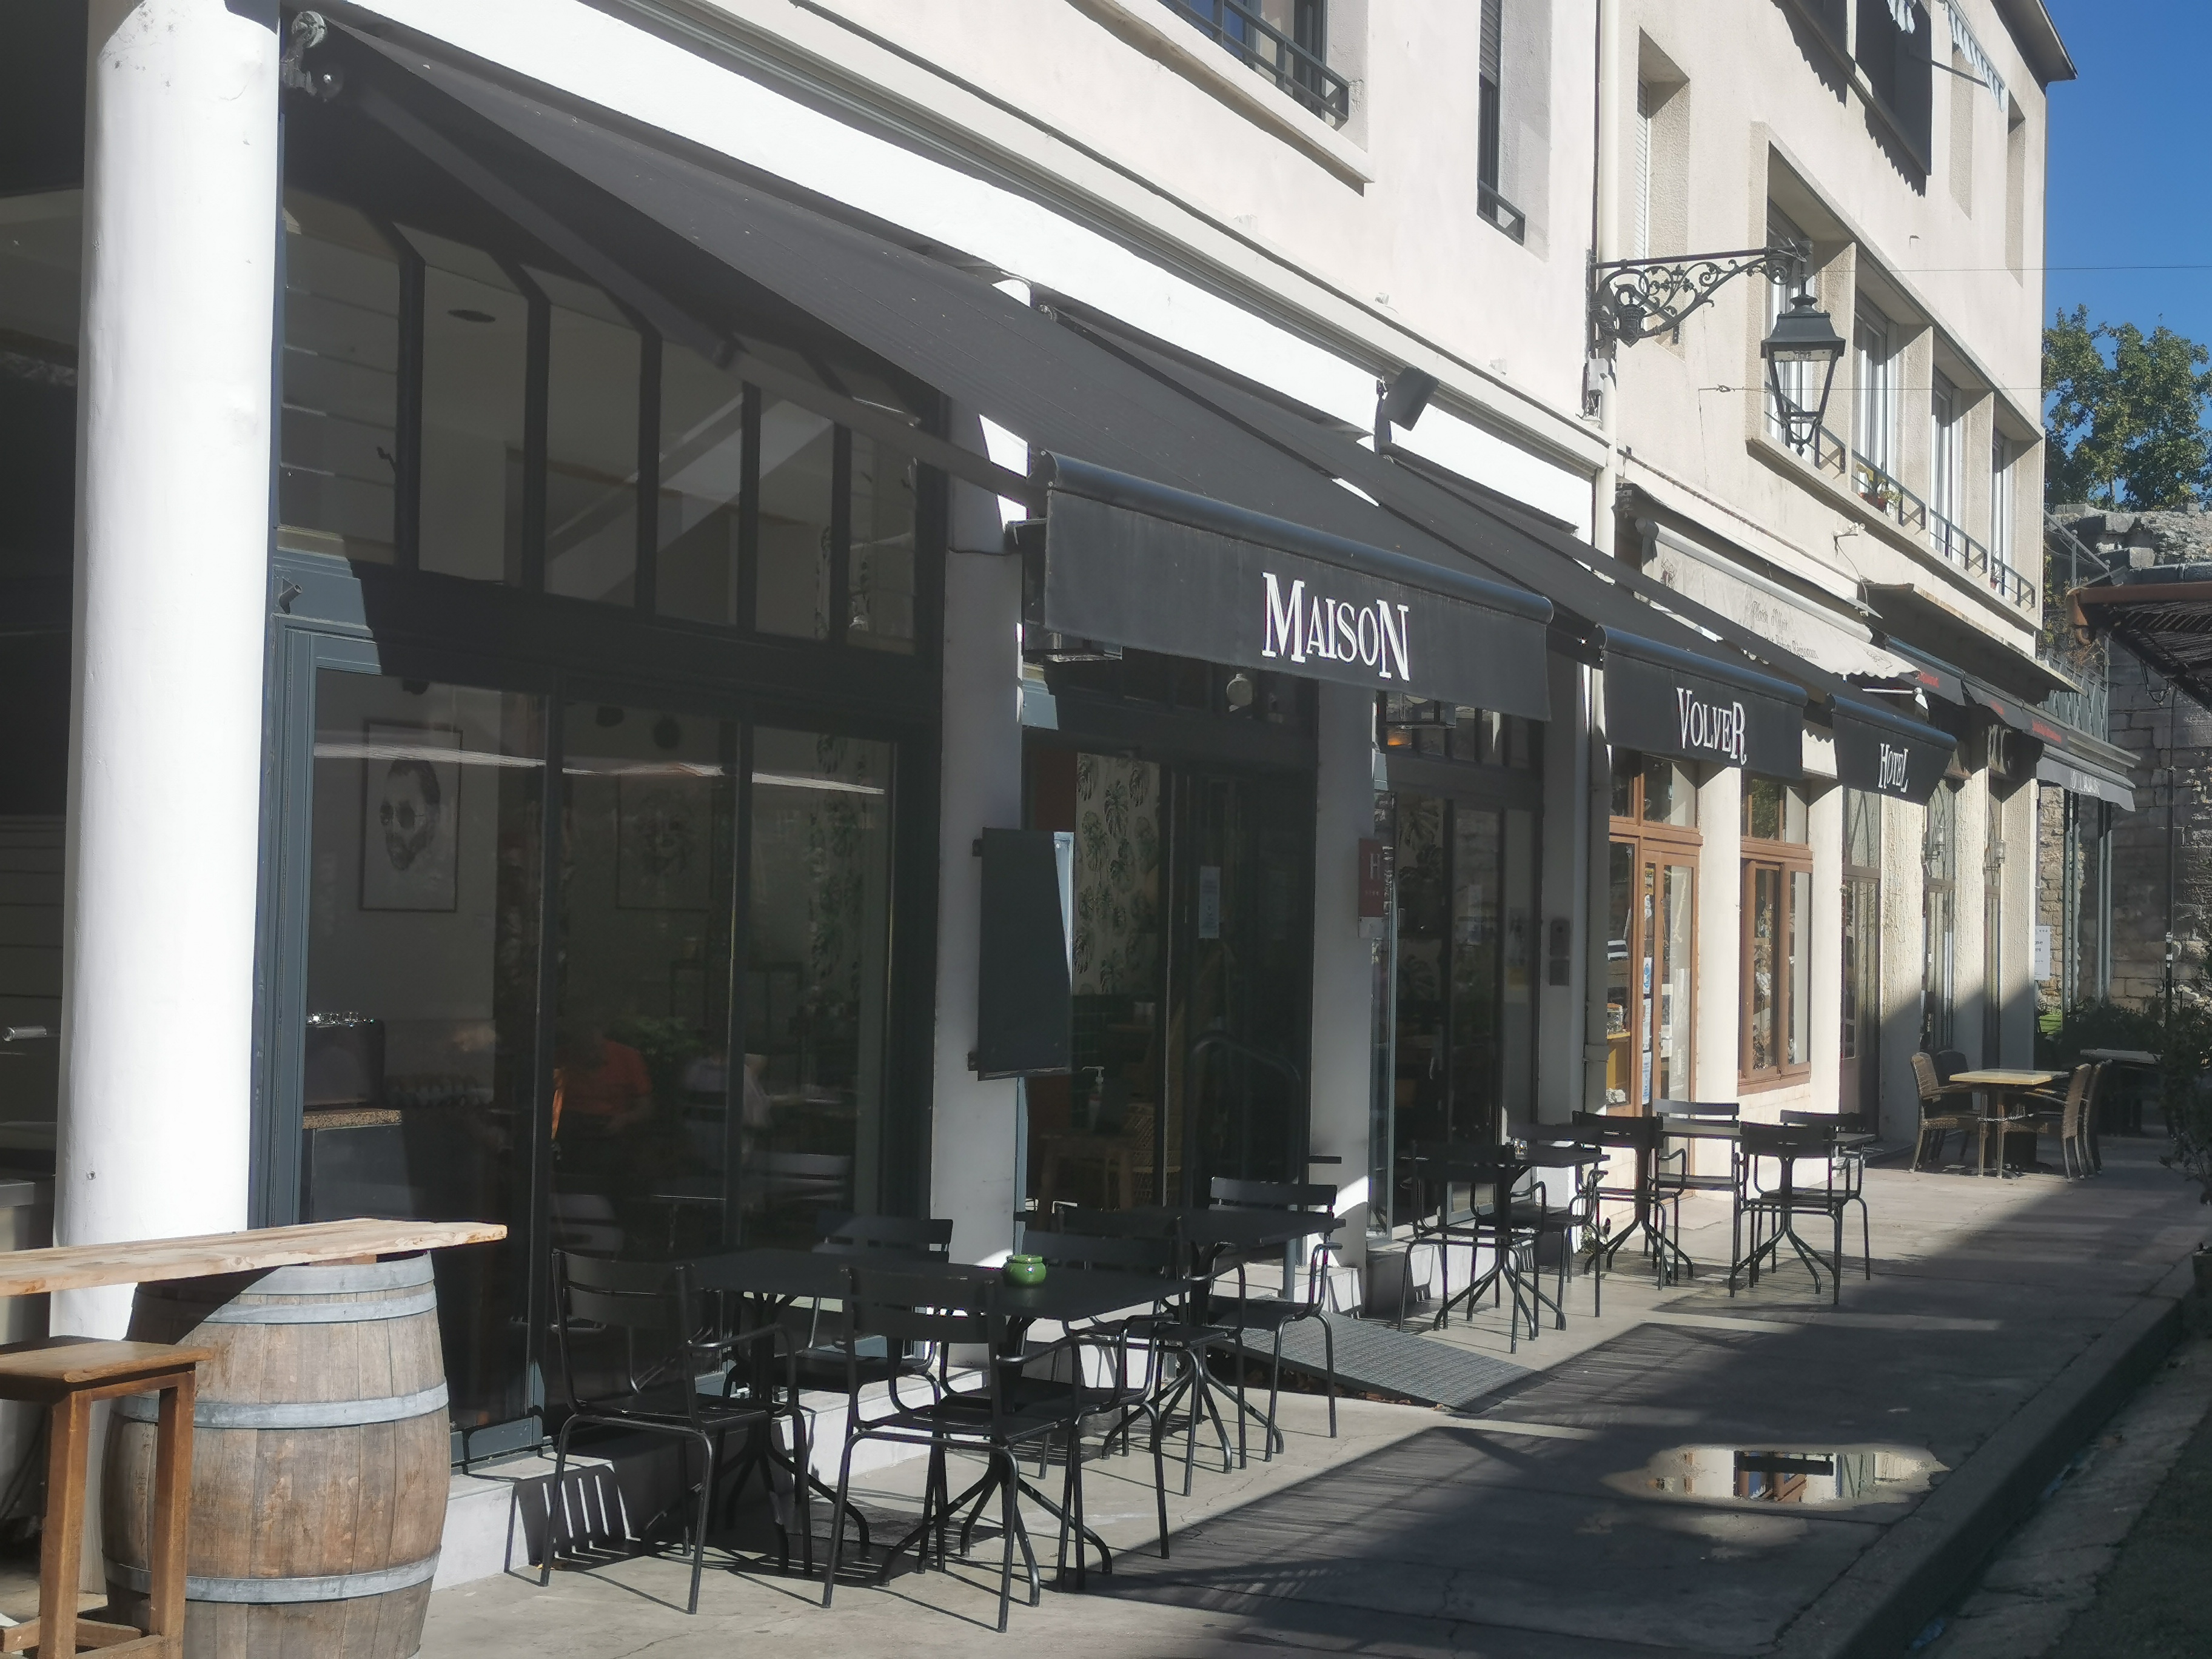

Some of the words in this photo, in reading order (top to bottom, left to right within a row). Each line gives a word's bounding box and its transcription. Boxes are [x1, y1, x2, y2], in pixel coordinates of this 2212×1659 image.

[1262, 572, 1410, 681] MAISON
[1676, 687, 1747, 765] VOLVER
[1878, 743, 1909, 793] HOTEL
